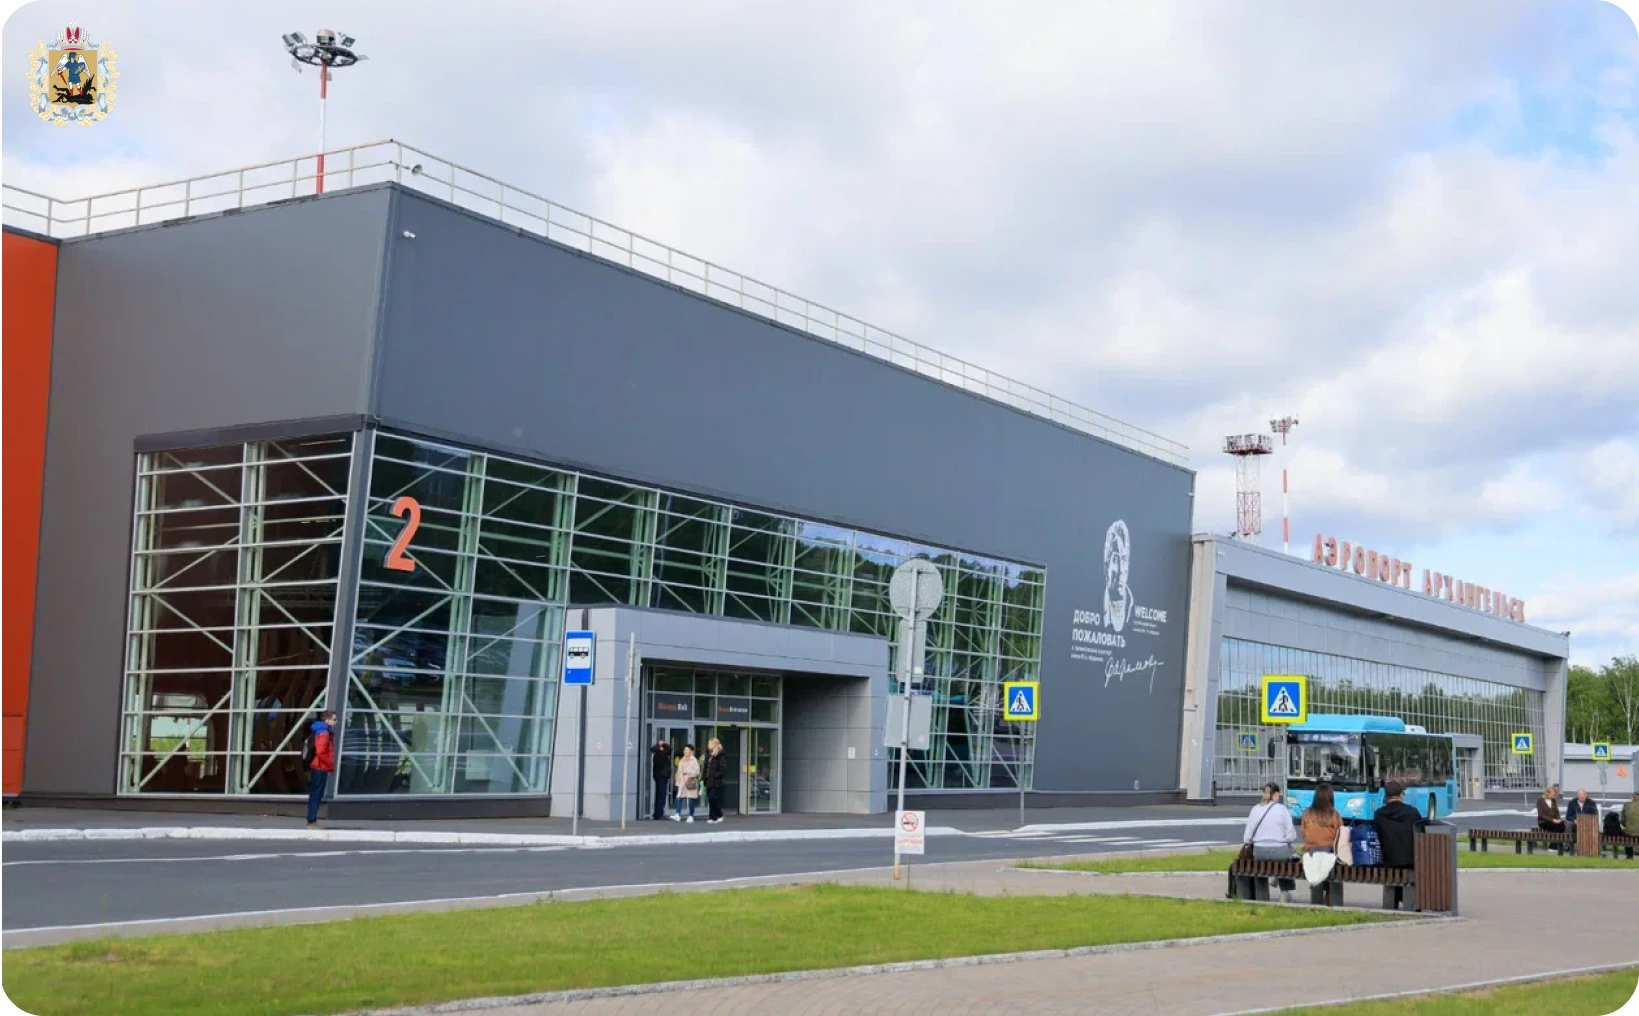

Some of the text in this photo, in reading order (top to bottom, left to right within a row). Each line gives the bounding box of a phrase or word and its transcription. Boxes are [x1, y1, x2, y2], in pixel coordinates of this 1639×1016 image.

[384, 496, 421, 571] 2
[1311, 533, 1525, 622] АЭРОПОРТ АРХАНГЕЛЬСК
[1073, 609, 1100, 626] ДОБРО
[1134, 605, 1167, 622] WELCOME
[1072, 628, 1126, 648] ПОЖАЛОВАТЬ
